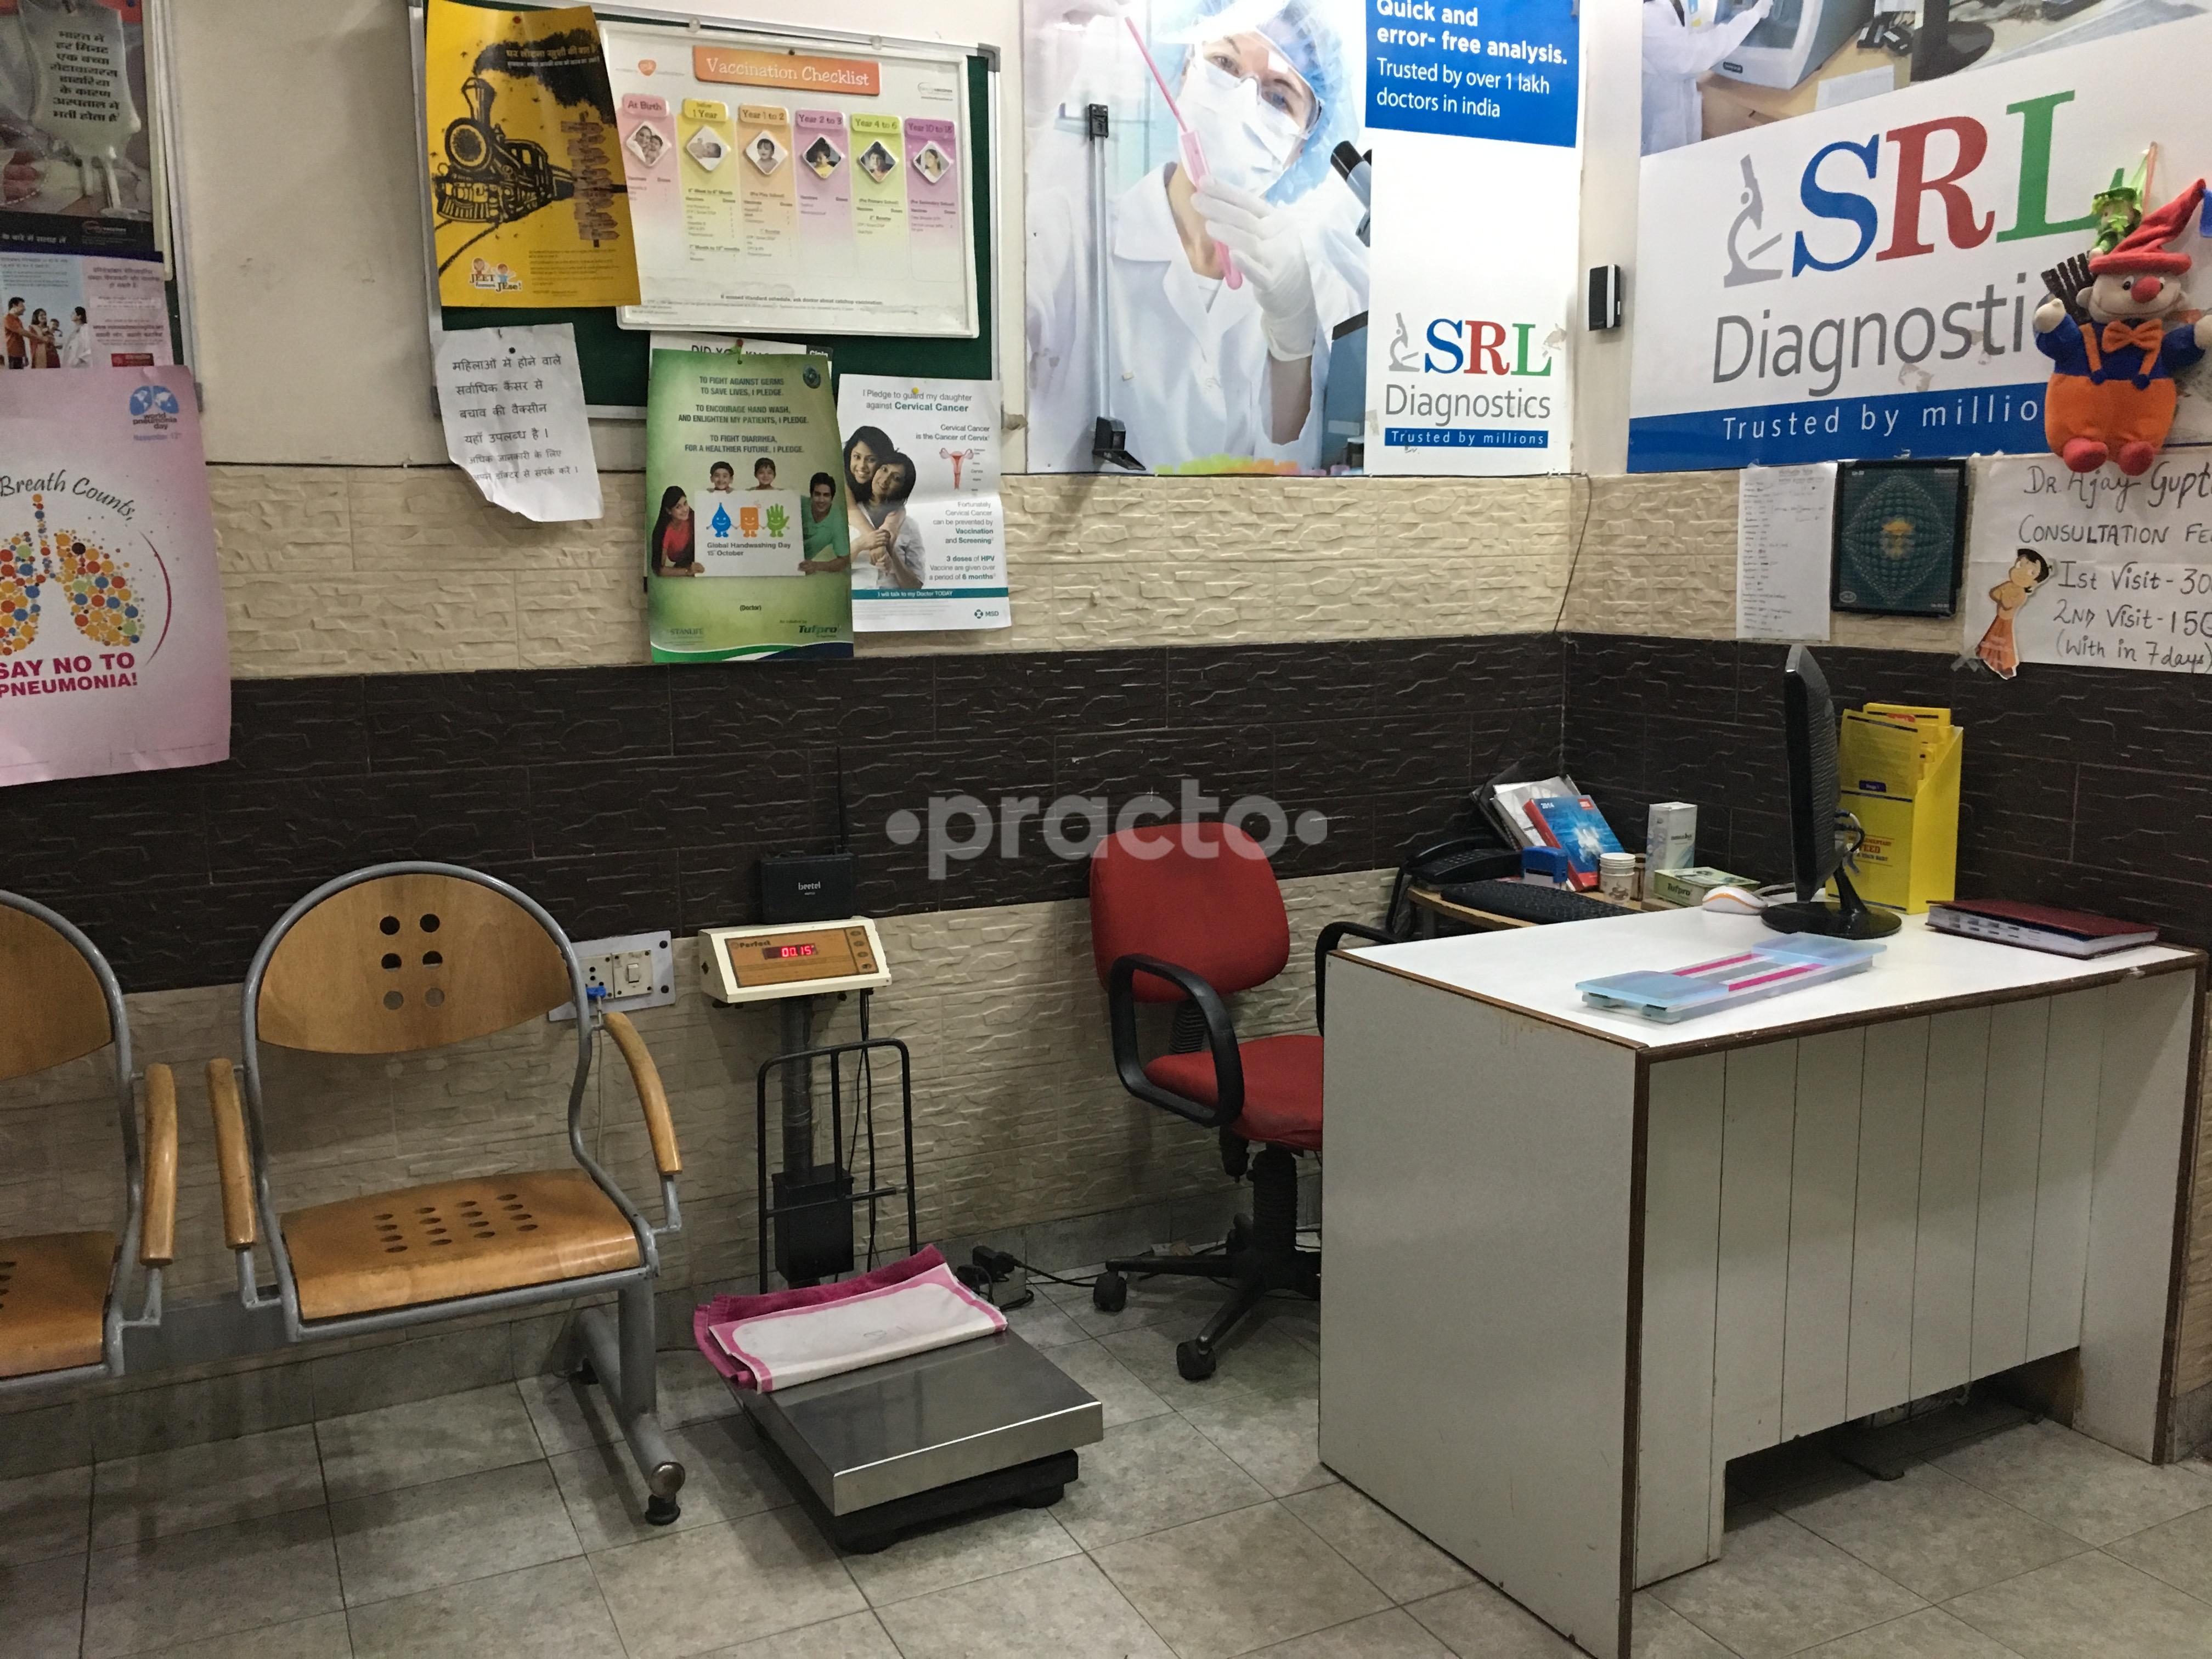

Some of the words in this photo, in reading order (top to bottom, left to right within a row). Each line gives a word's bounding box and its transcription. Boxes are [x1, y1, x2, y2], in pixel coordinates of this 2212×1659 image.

[1376, 0, 1436, 22] Quick
[1441, 7, 1479, 27] and
[1377, 27, 1436, 47] error-
[1441, 30, 1481, 54] free
[1487, 40, 1568, 65] analysis.
[706, 57, 798, 81] Vaccination
[802, 66, 870, 86] Checklist
[1376, 57, 1438, 82] Trusted
[1442, 64, 1463, 89] by
[1466, 72, 1502, 88] over
[1506, 73, 1511, 90] 1
[1518, 72, 1550, 95] lakh
[628, 100, 638, 109] At
[640, 100, 662, 111] Birth
[1376, 87, 1438, 111] doctors
[1443, 94, 1457, 112] in
[1462, 97, 1500, 118] india
[699, 110, 718, 119] Year
[742, 110, 760, 119] Year
[799, 114, 816, 122] Year
[855, 119, 872, 127] Year
[1791, 89, 2125, 278] SRL
[1713, 272, 2052, 397] Diagnosti
[1425, 318, 1552, 376] SRL
[518, 355, 535, 368] होने
[542, 354, 561, 365] वाले
[534, 378, 543, 390] से
[867, 390, 891, 399] Pledge
[903, 392, 924, 400] guard
[939, 393, 972, 402] daughter
[459, 408, 486, 419] बचाव
[493, 404, 505, 416] की
[706, 405, 746, 413] ENCOURAGE
[895, 402, 933, 411] Cervical
[935, 403, 968, 412] Cancer
[1385, 383, 1550, 427] Diagnostics
[693, 415, 729, 424] ENLIGHTEN
[1723, 407, 1839, 440] Trusted
[1861, 404, 1900, 437] by
[1922, 394, 2038, 427] millio
[940, 424, 966, 432] Cervical
[489, 430, 526, 443] उपलब्ध
[1391, 430, 1450, 443] Trusted
[1459, 431, 1475, 446] by
[1483, 432, 1544, 445] millions
[2068, 470, 2141, 512] Ajay
[2148, 461, 2212, 509] Gupt
[0, 469, 66, 496] Breath
[72, 477, 136, 521] Counts,
[2019, 515, 2170, 546] CONSULTATION
[2185, 523, 2212, 543] FE
[2180, 569, 2212, 595] 30
[799, 625, 838, 634] Tufpro
[2118, 639, 2137, 662] in
[0, 659, 43, 679] SAY
[53, 656, 92, 674] NO
[99, 652, 135, 670] TO
[0, 673, 138, 698] PNEUMONIA!
[798, 881, 821, 890] beetel
[1667, 883, 1691, 896] Tufpro
